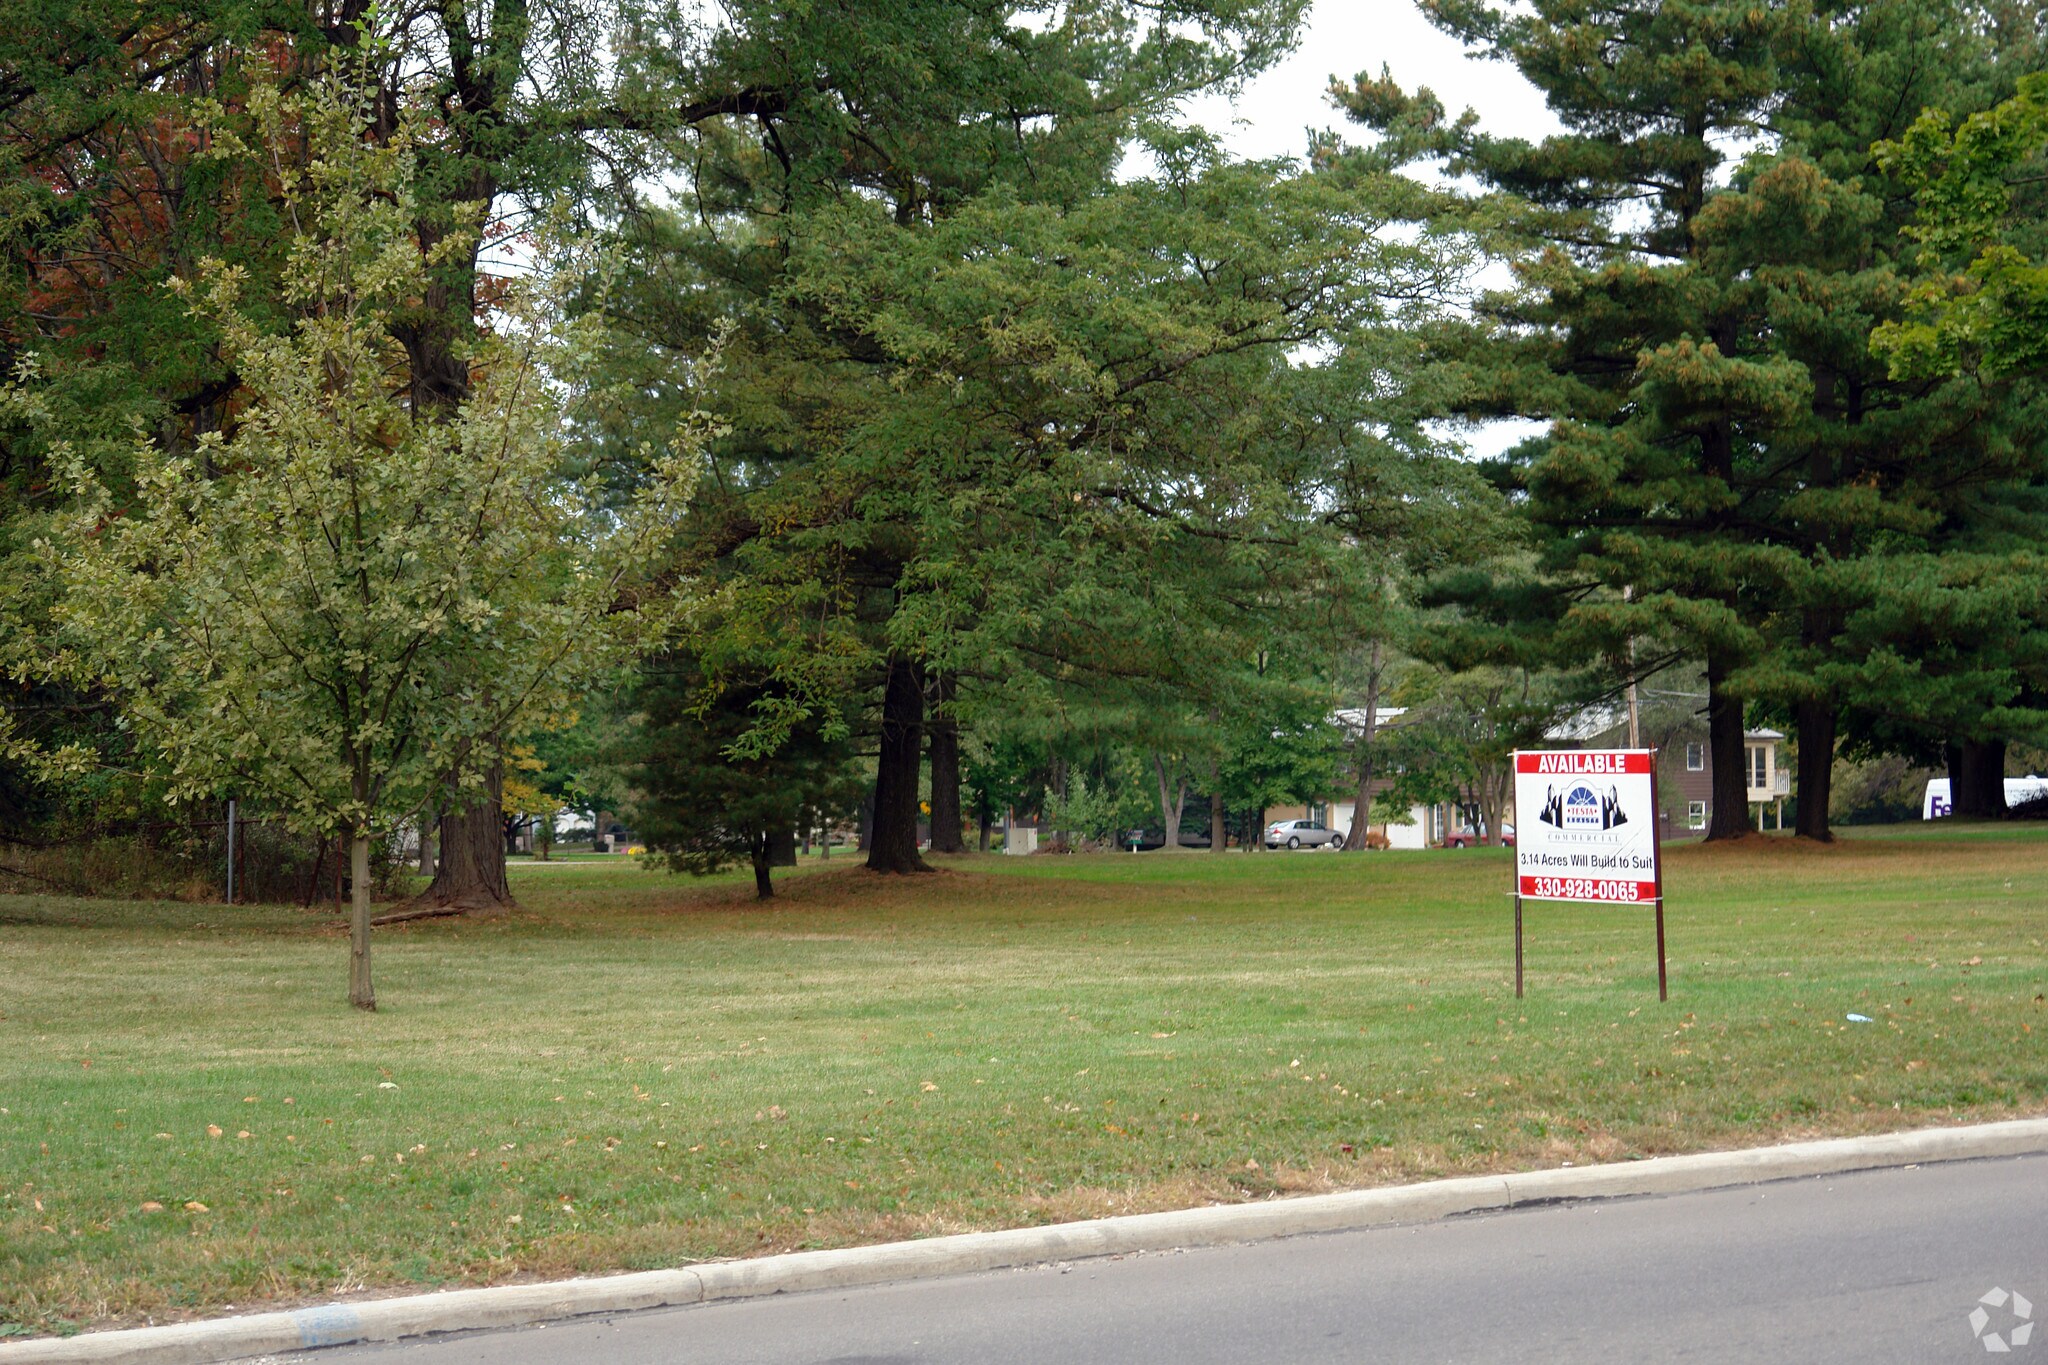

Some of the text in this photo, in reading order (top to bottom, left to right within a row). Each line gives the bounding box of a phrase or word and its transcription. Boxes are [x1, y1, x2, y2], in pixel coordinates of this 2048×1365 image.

[1538, 754, 1626, 772] AVAILABLE
[1571, 807, 1594, 816] TESTA
[1547, 833, 1620, 842] COMMERCIAL
[1521, 853, 1653, 869] 3.14 Acres Will Build to Suit
[1534, 877, 1638, 900] 330-928-0065
